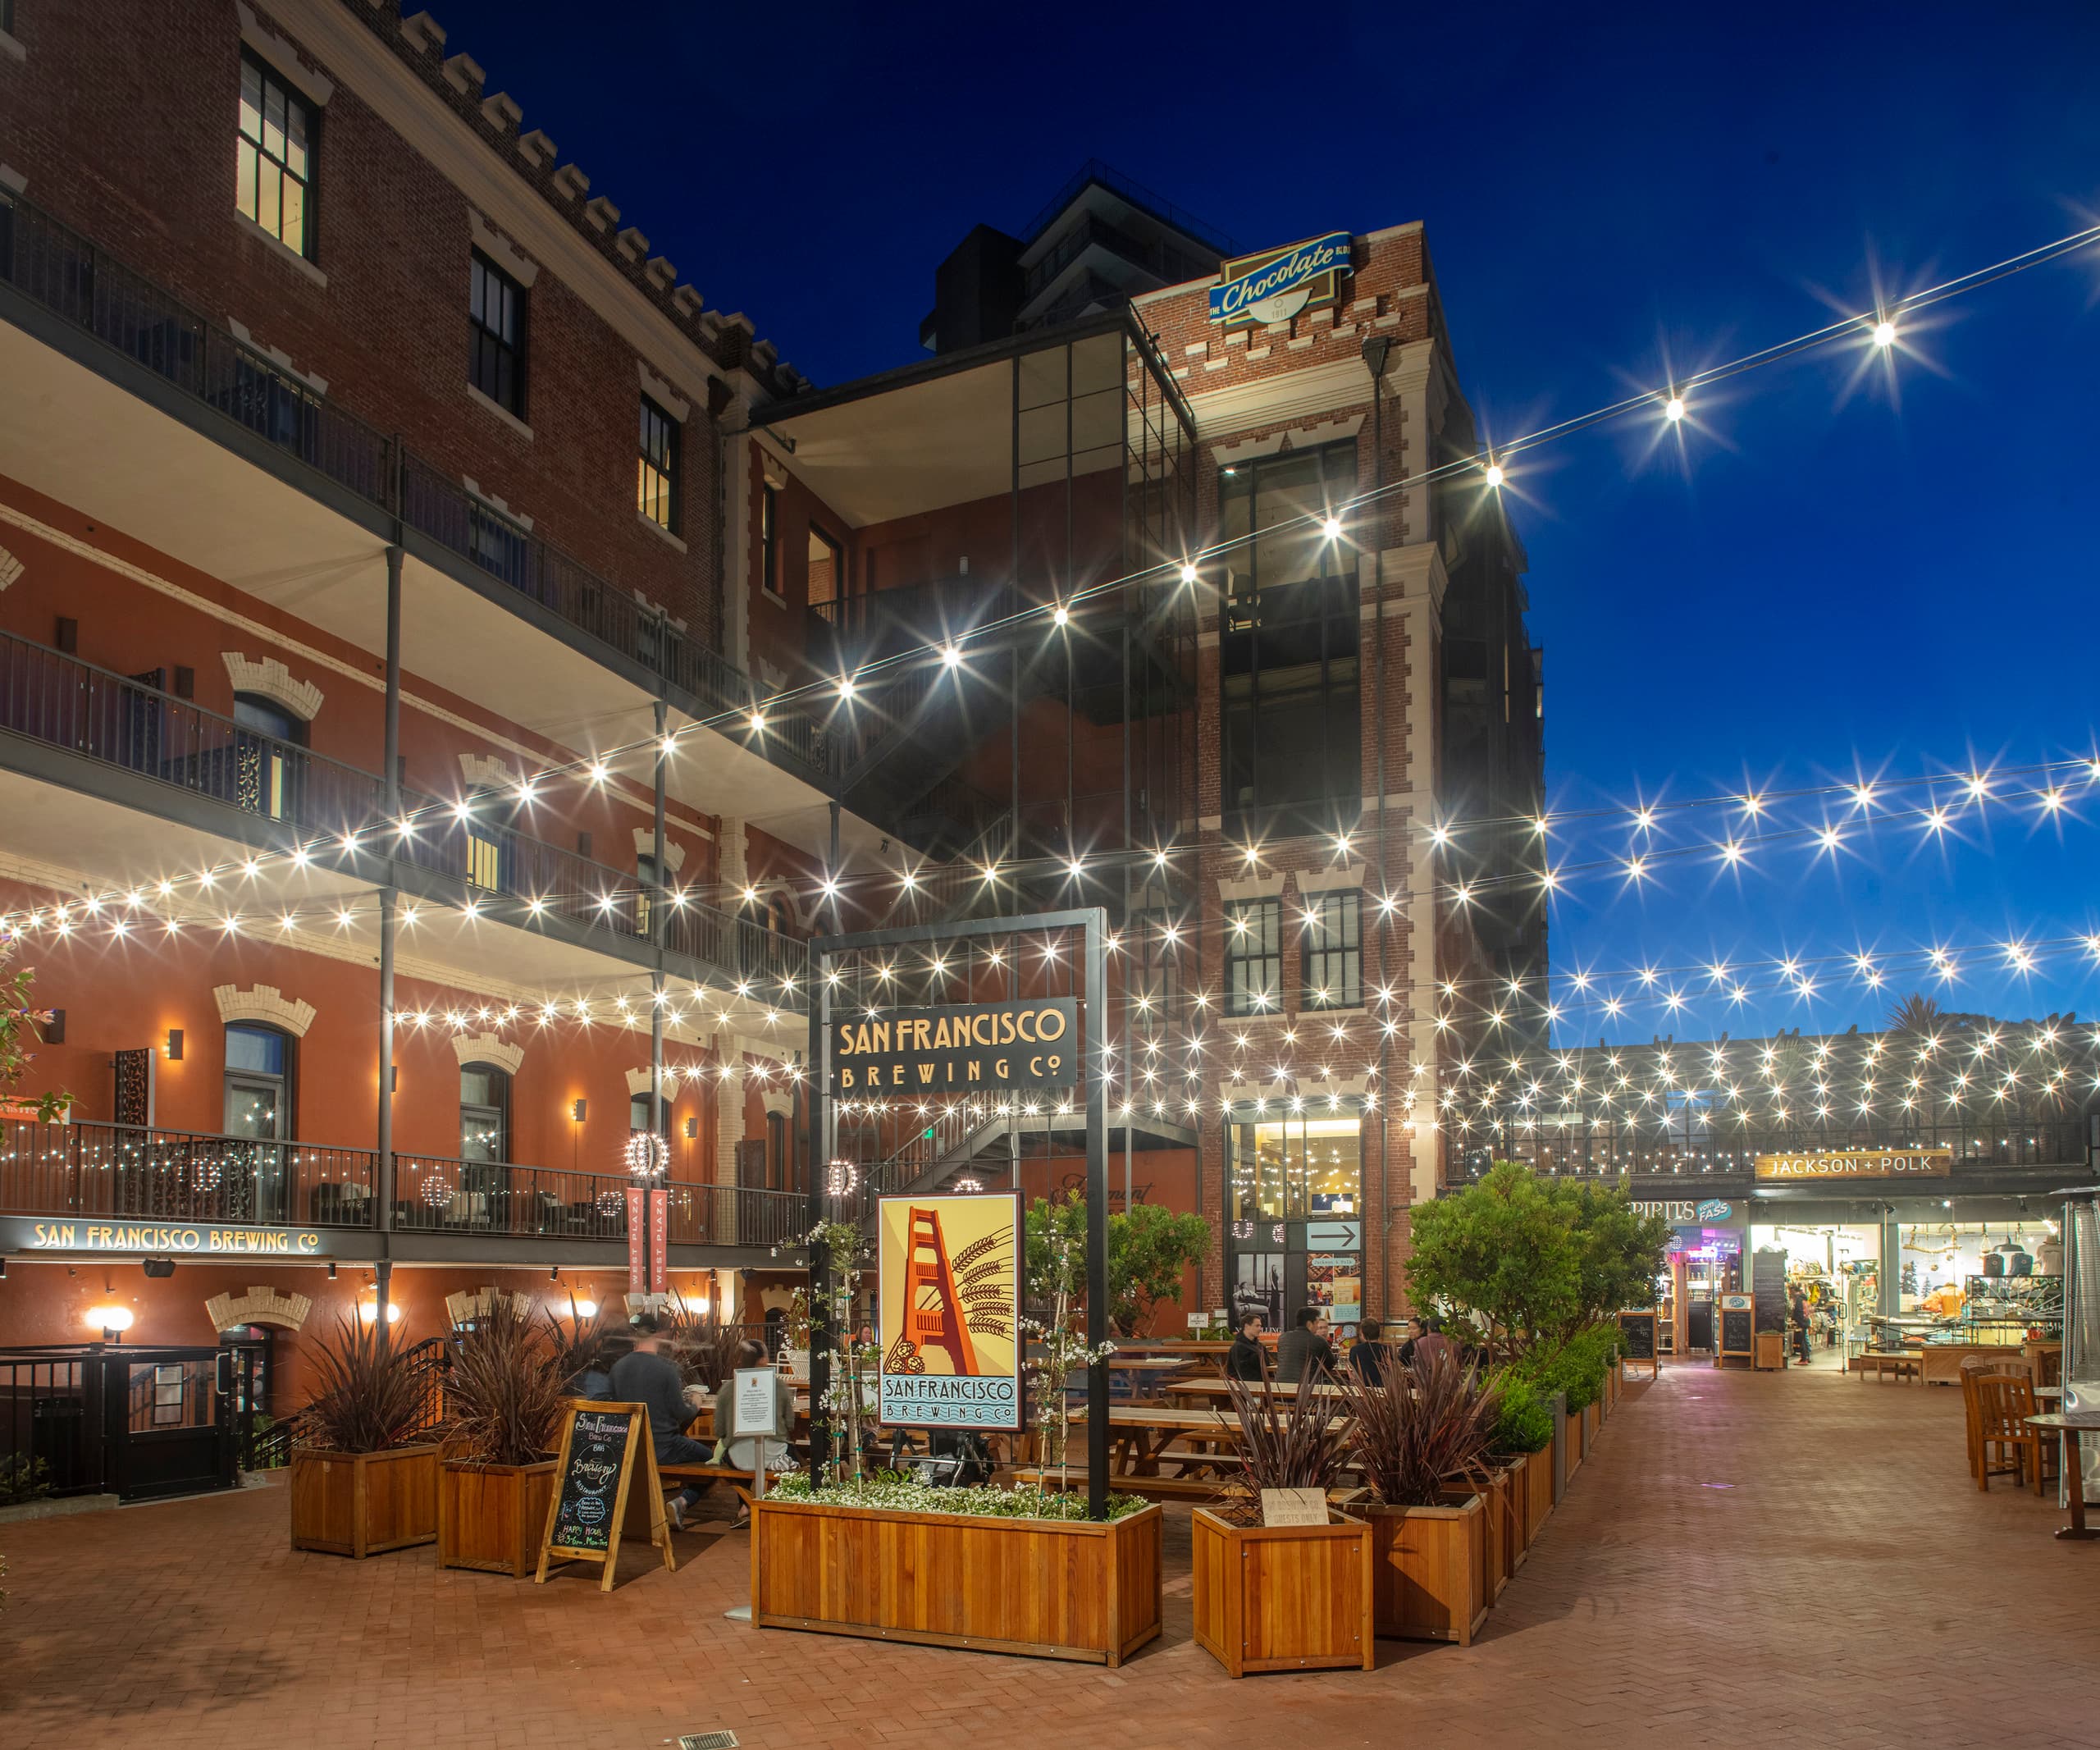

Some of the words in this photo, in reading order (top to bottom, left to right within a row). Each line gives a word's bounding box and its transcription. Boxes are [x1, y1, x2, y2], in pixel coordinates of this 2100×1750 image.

[1209, 306, 1221, 316] THE
[1222, 243, 1335, 313] Chocolate
[1272, 308, 1287, 319] 1911
[839, 1021, 891, 1056] SAN
[896, 1008, 1066, 1051] FRANCISCO
[842, 1058, 1010, 1089] BREWING
[1772, 1158, 1858, 1174] JACKSON
[1865, 1161, 1874, 1169] +
[1881, 1156, 1932, 1172] POLK
[1699, 1202, 1728, 1222] FASS
[1700, 1201, 1714, 1212] vom
[34, 1224, 75, 1248] SAN
[86, 1226, 200, 1251] FRANCISCO
[209, 1230, 289, 1253] BREWING
[885, 1379, 914, 1397] SAN
[919, 1380, 1013, 1400] FRANCISCO
[887, 1405, 982, 1419] BREWING
